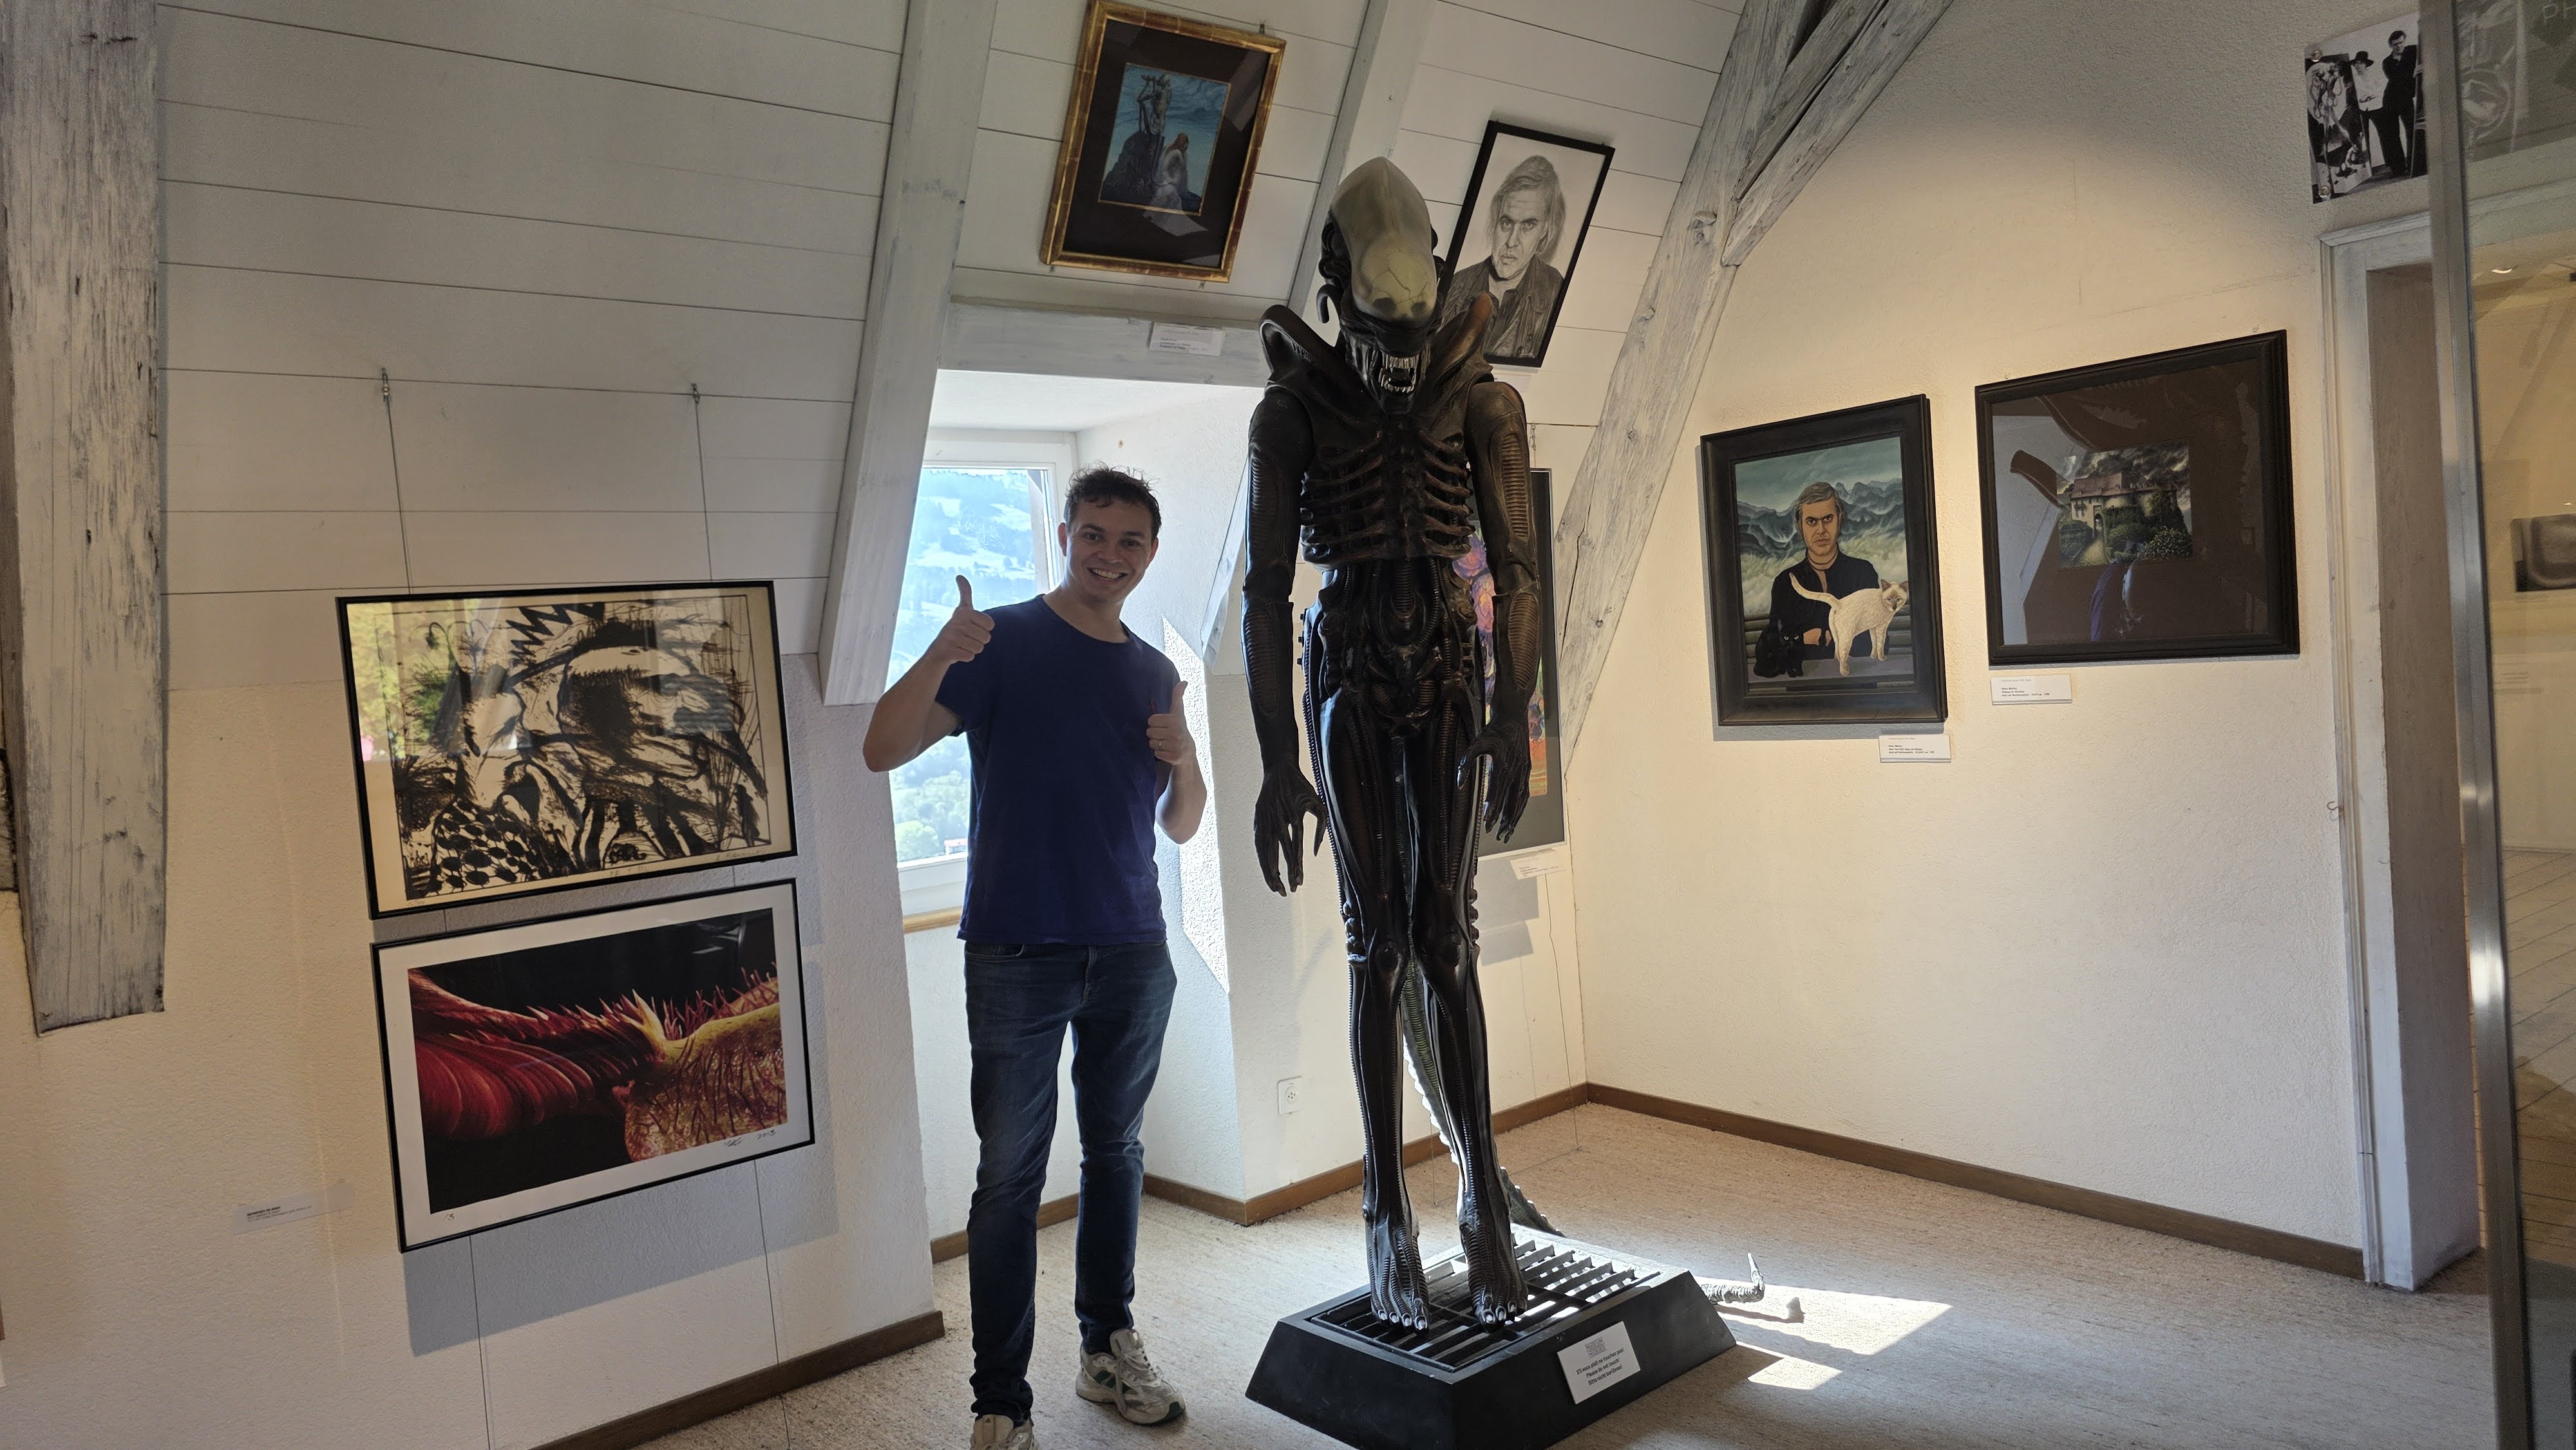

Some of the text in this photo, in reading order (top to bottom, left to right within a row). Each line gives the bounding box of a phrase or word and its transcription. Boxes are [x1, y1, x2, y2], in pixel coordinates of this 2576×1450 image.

[1603, 1352, 1616, 1362] touchez
[1586, 1370, 1598, 1378] Please
[1609, 1358, 1620, 1367] touch!
[1605, 1364, 1623, 1377] berühren!
